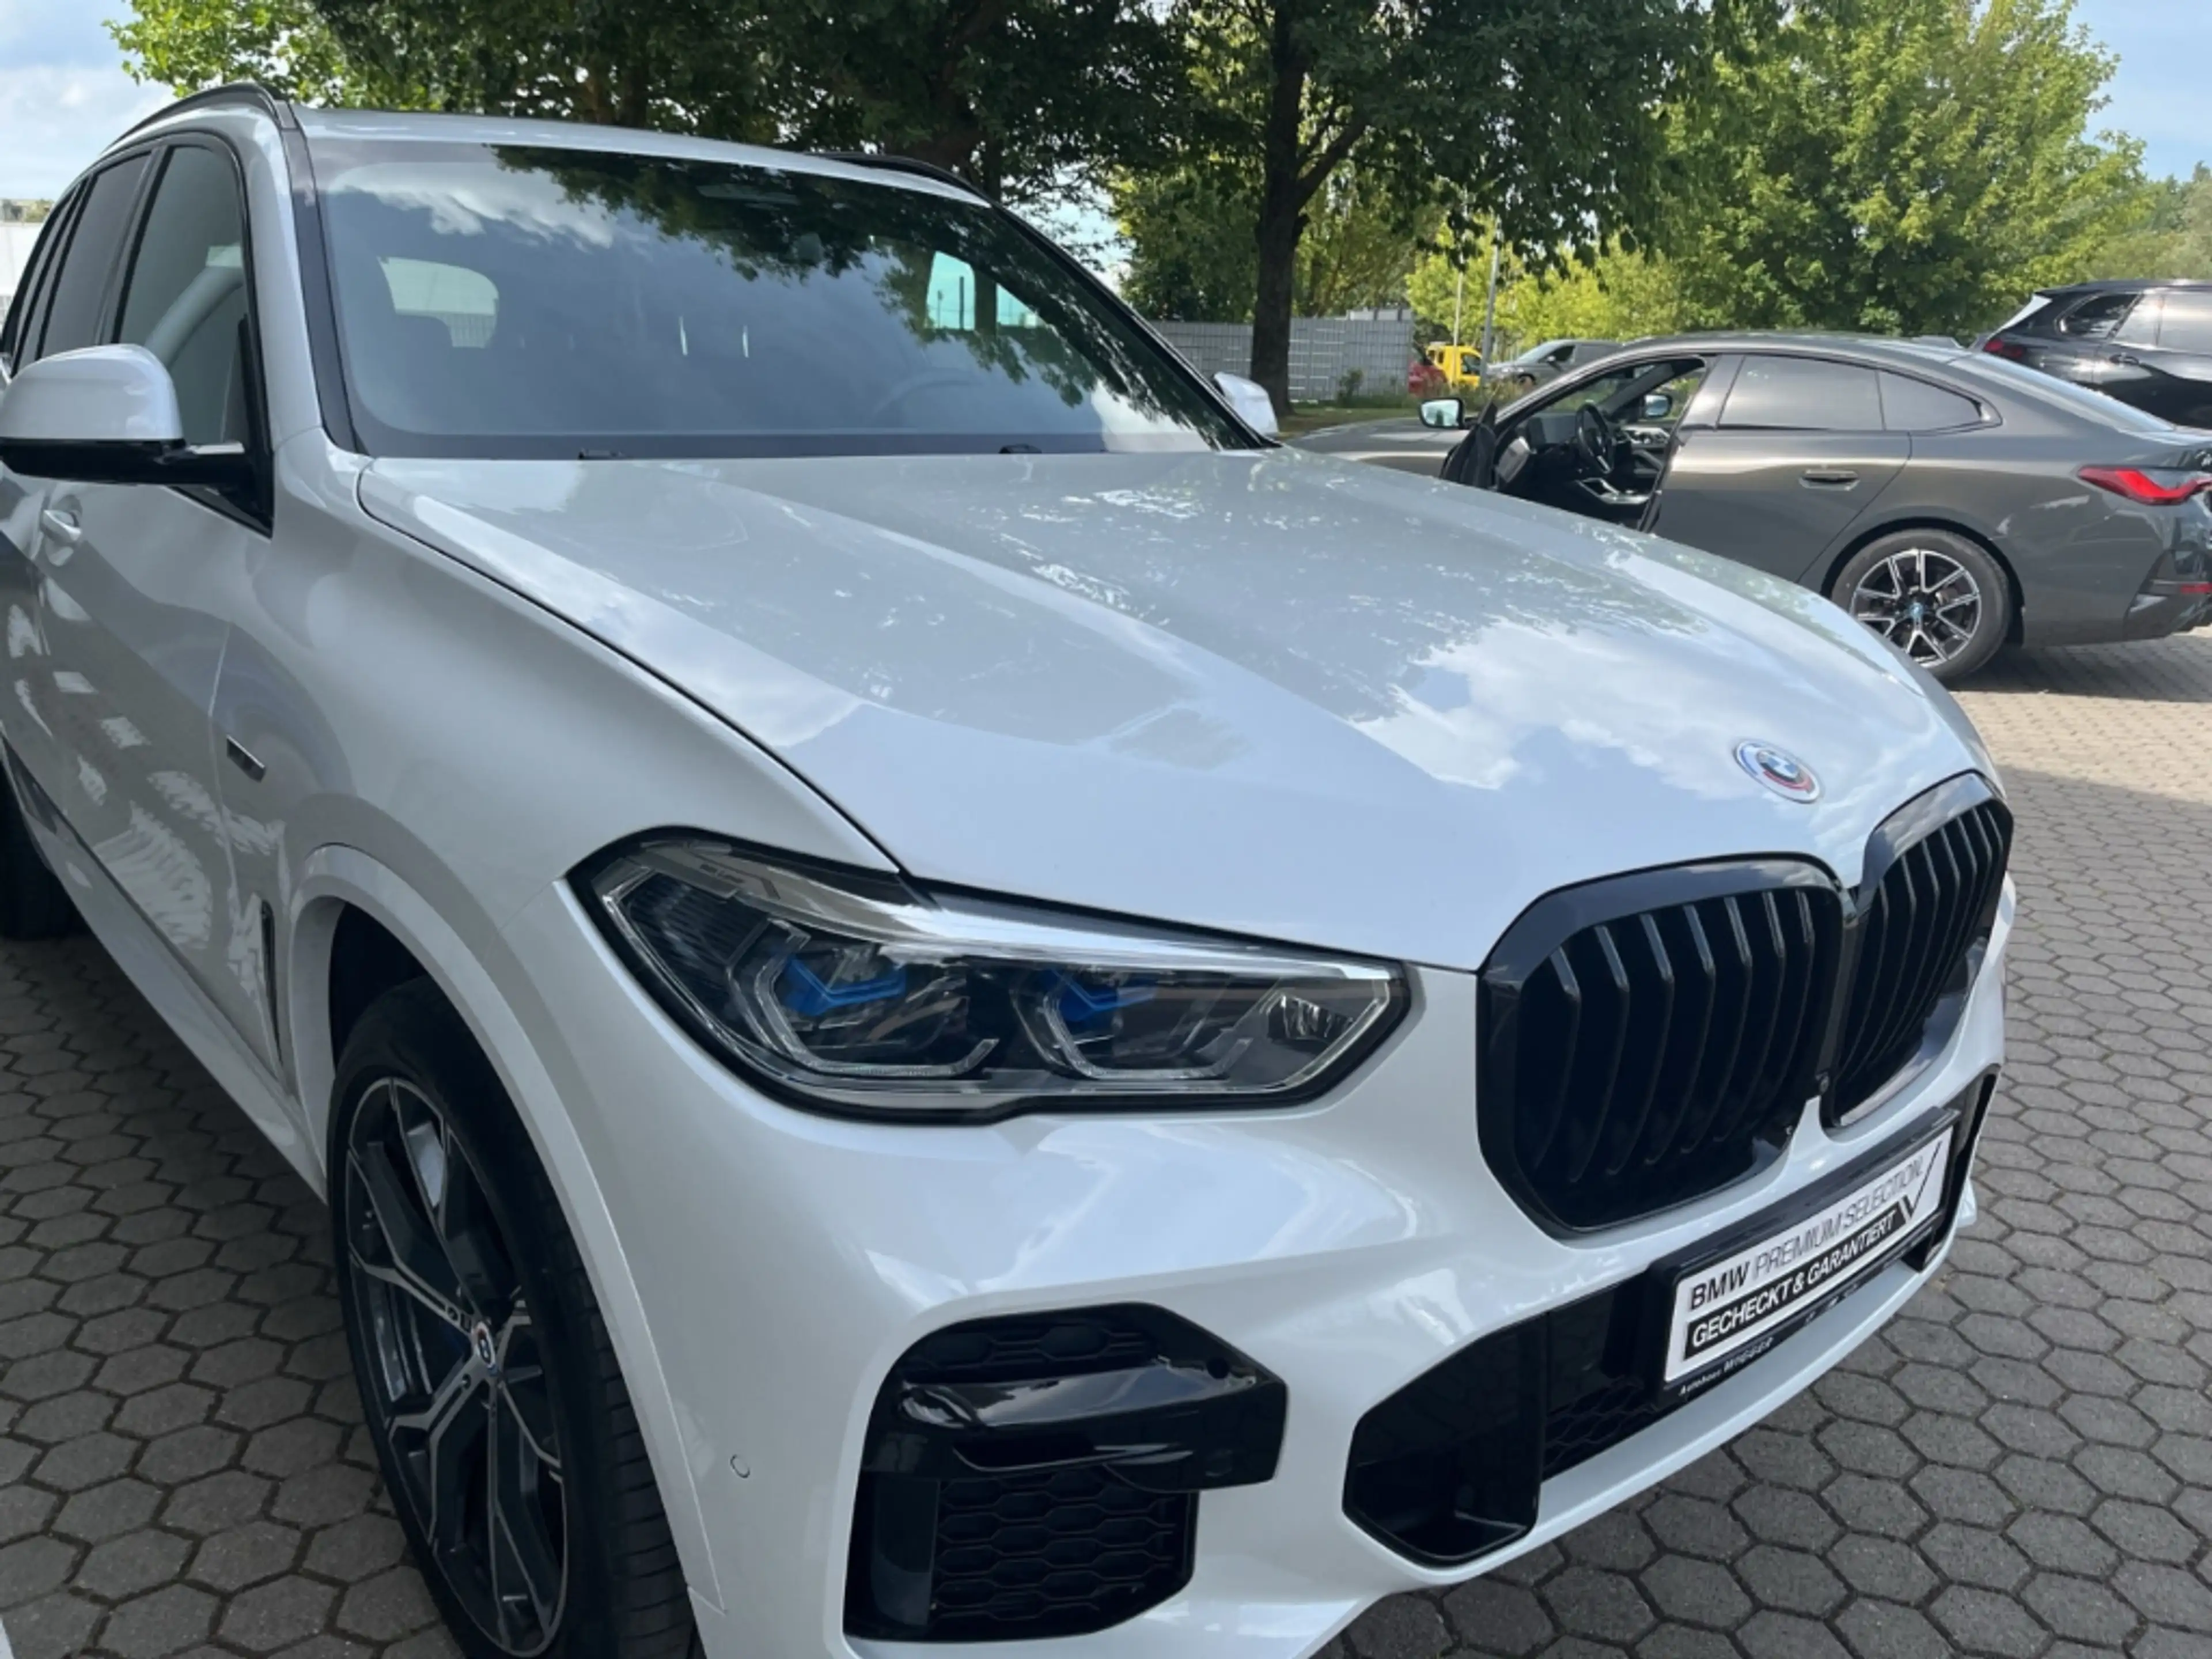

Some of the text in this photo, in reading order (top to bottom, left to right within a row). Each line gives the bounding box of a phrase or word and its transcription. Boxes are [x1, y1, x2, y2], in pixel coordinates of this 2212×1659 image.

[1690, 1262, 1751, 1310] BMW
[1752, 1212, 1842, 1280] PREMIUM
[1844, 1156, 1923, 1228] SELECTION
[1692, 1278, 1793, 1347] GECHECKT
[1793, 1271, 1805, 1295] &
[1808, 1209, 1897, 1285] GARANTIERT
